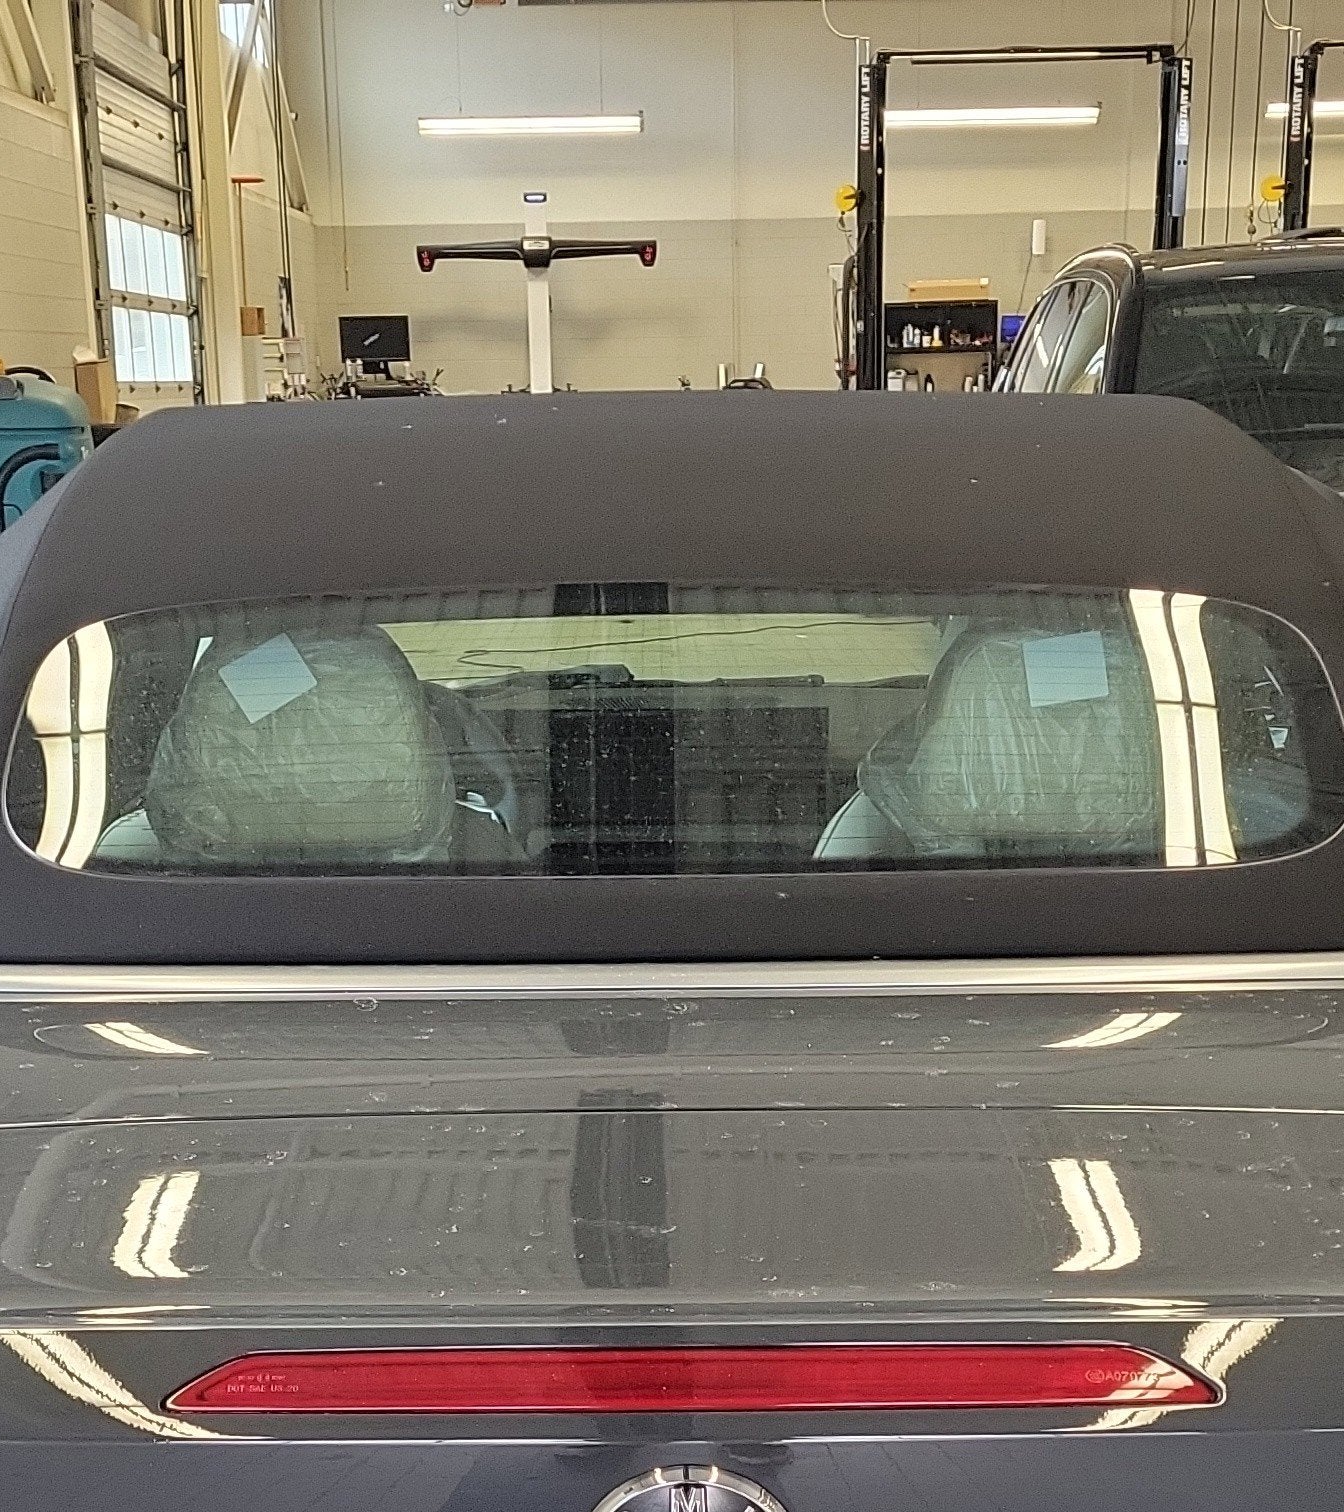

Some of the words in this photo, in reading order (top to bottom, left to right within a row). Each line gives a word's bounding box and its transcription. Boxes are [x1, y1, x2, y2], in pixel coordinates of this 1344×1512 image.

[861, 67, 871, 92] LIFT
[1182, 59, 1190, 85] LIFT
[1294, 58, 1304, 83] LIFT
[861, 95, 870, 144] ROTARY
[1291, 86, 1302, 135] ROTARY
